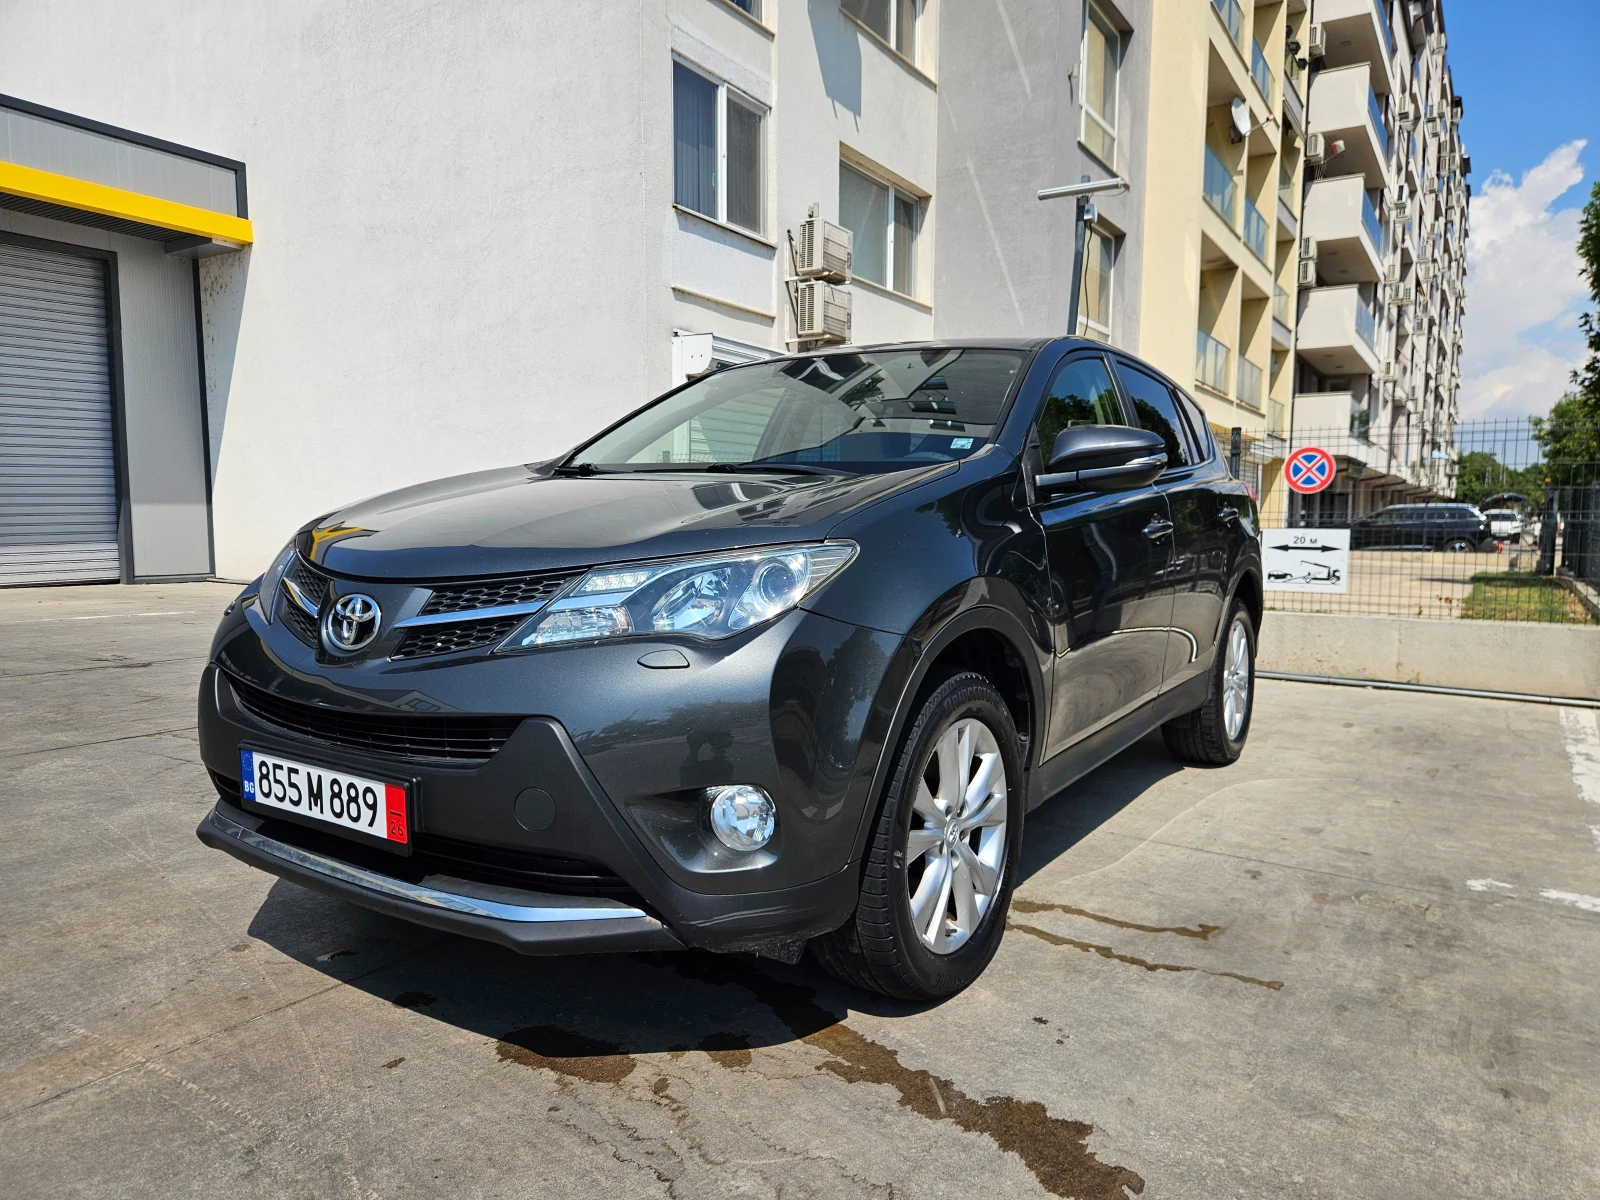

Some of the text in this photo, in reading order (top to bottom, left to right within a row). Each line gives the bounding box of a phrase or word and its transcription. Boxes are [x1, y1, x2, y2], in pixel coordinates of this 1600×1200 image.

[1293, 535, 1306, 545] 20
[244, 780, 255, 794] BG
[390, 820, 404, 836] 26
